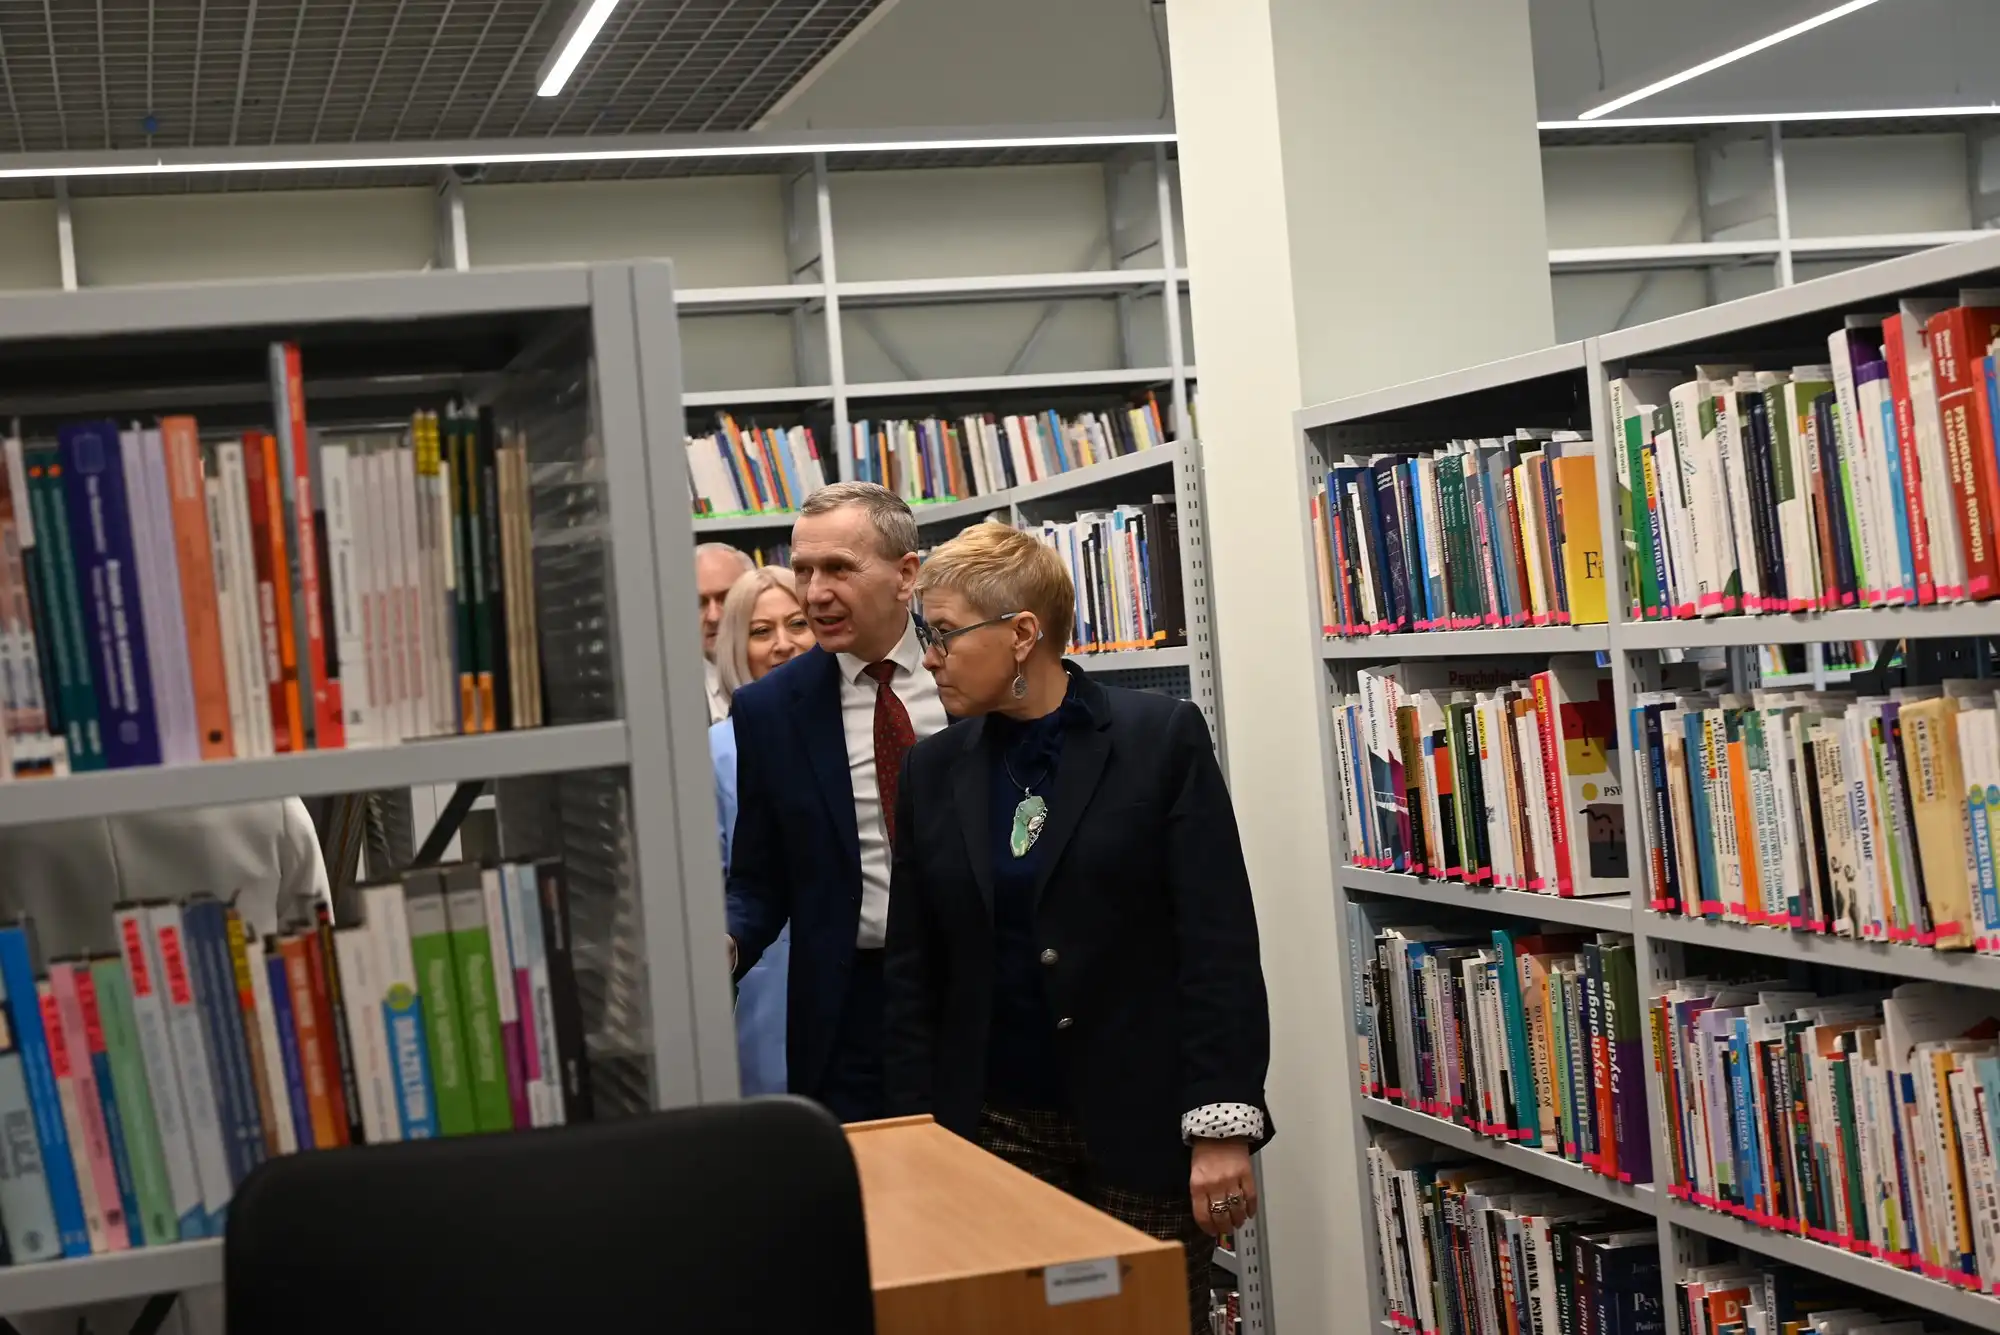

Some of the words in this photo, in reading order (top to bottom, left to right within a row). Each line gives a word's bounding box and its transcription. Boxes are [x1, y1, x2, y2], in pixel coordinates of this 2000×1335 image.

[1610, 386, 1624, 437] Psychologia
[1617, 439, 1628, 474] zdrowia
[1952, 404, 1976, 495] PSYCHOLOGIA
[1964, 497, 1986, 562] ROZWOJU
[1652, 538, 1664, 581] STRESU
[1364, 676, 1376, 718] Psychologia
[1370, 719, 1379, 750] kliniczna
[1853, 780, 1873, 862] DORASTANIE
[1972, 808, 1995, 889] BRAZELTON
[1347, 938, 1365, 1025] psychologia
[1364, 1014, 1378, 1073] PSYCHOLOGIA
